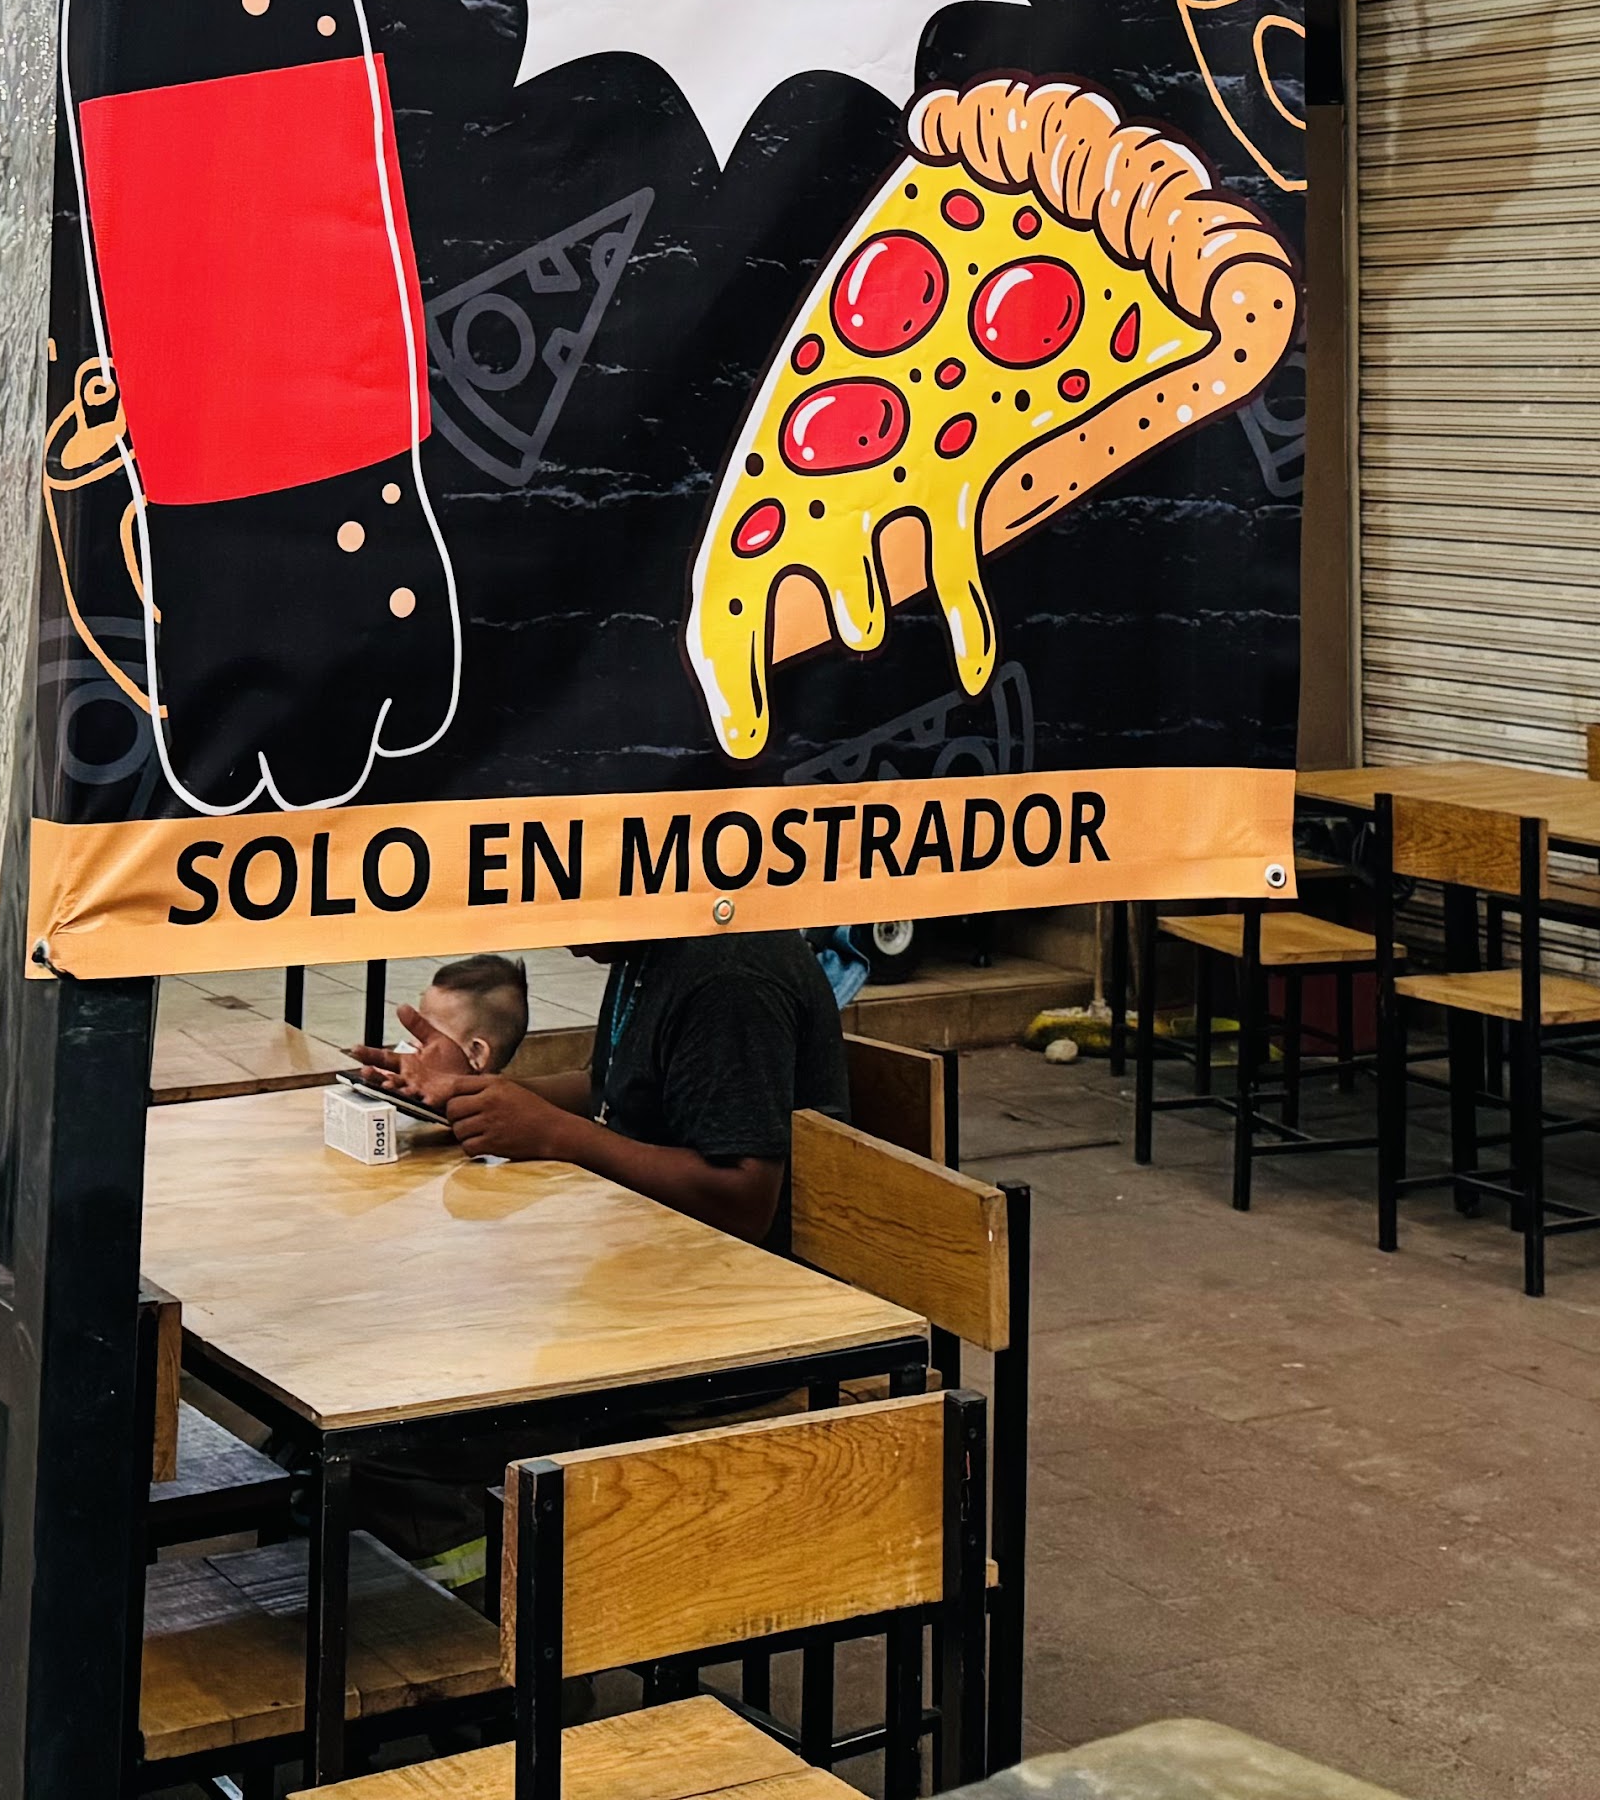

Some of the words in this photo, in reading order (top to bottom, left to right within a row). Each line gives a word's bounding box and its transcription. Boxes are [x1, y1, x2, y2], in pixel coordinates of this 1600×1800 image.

[168, 825, 431, 927] SOLO
[467, 818, 584, 906] EN
[617, 790, 1111, 898] MOSTRADOR
